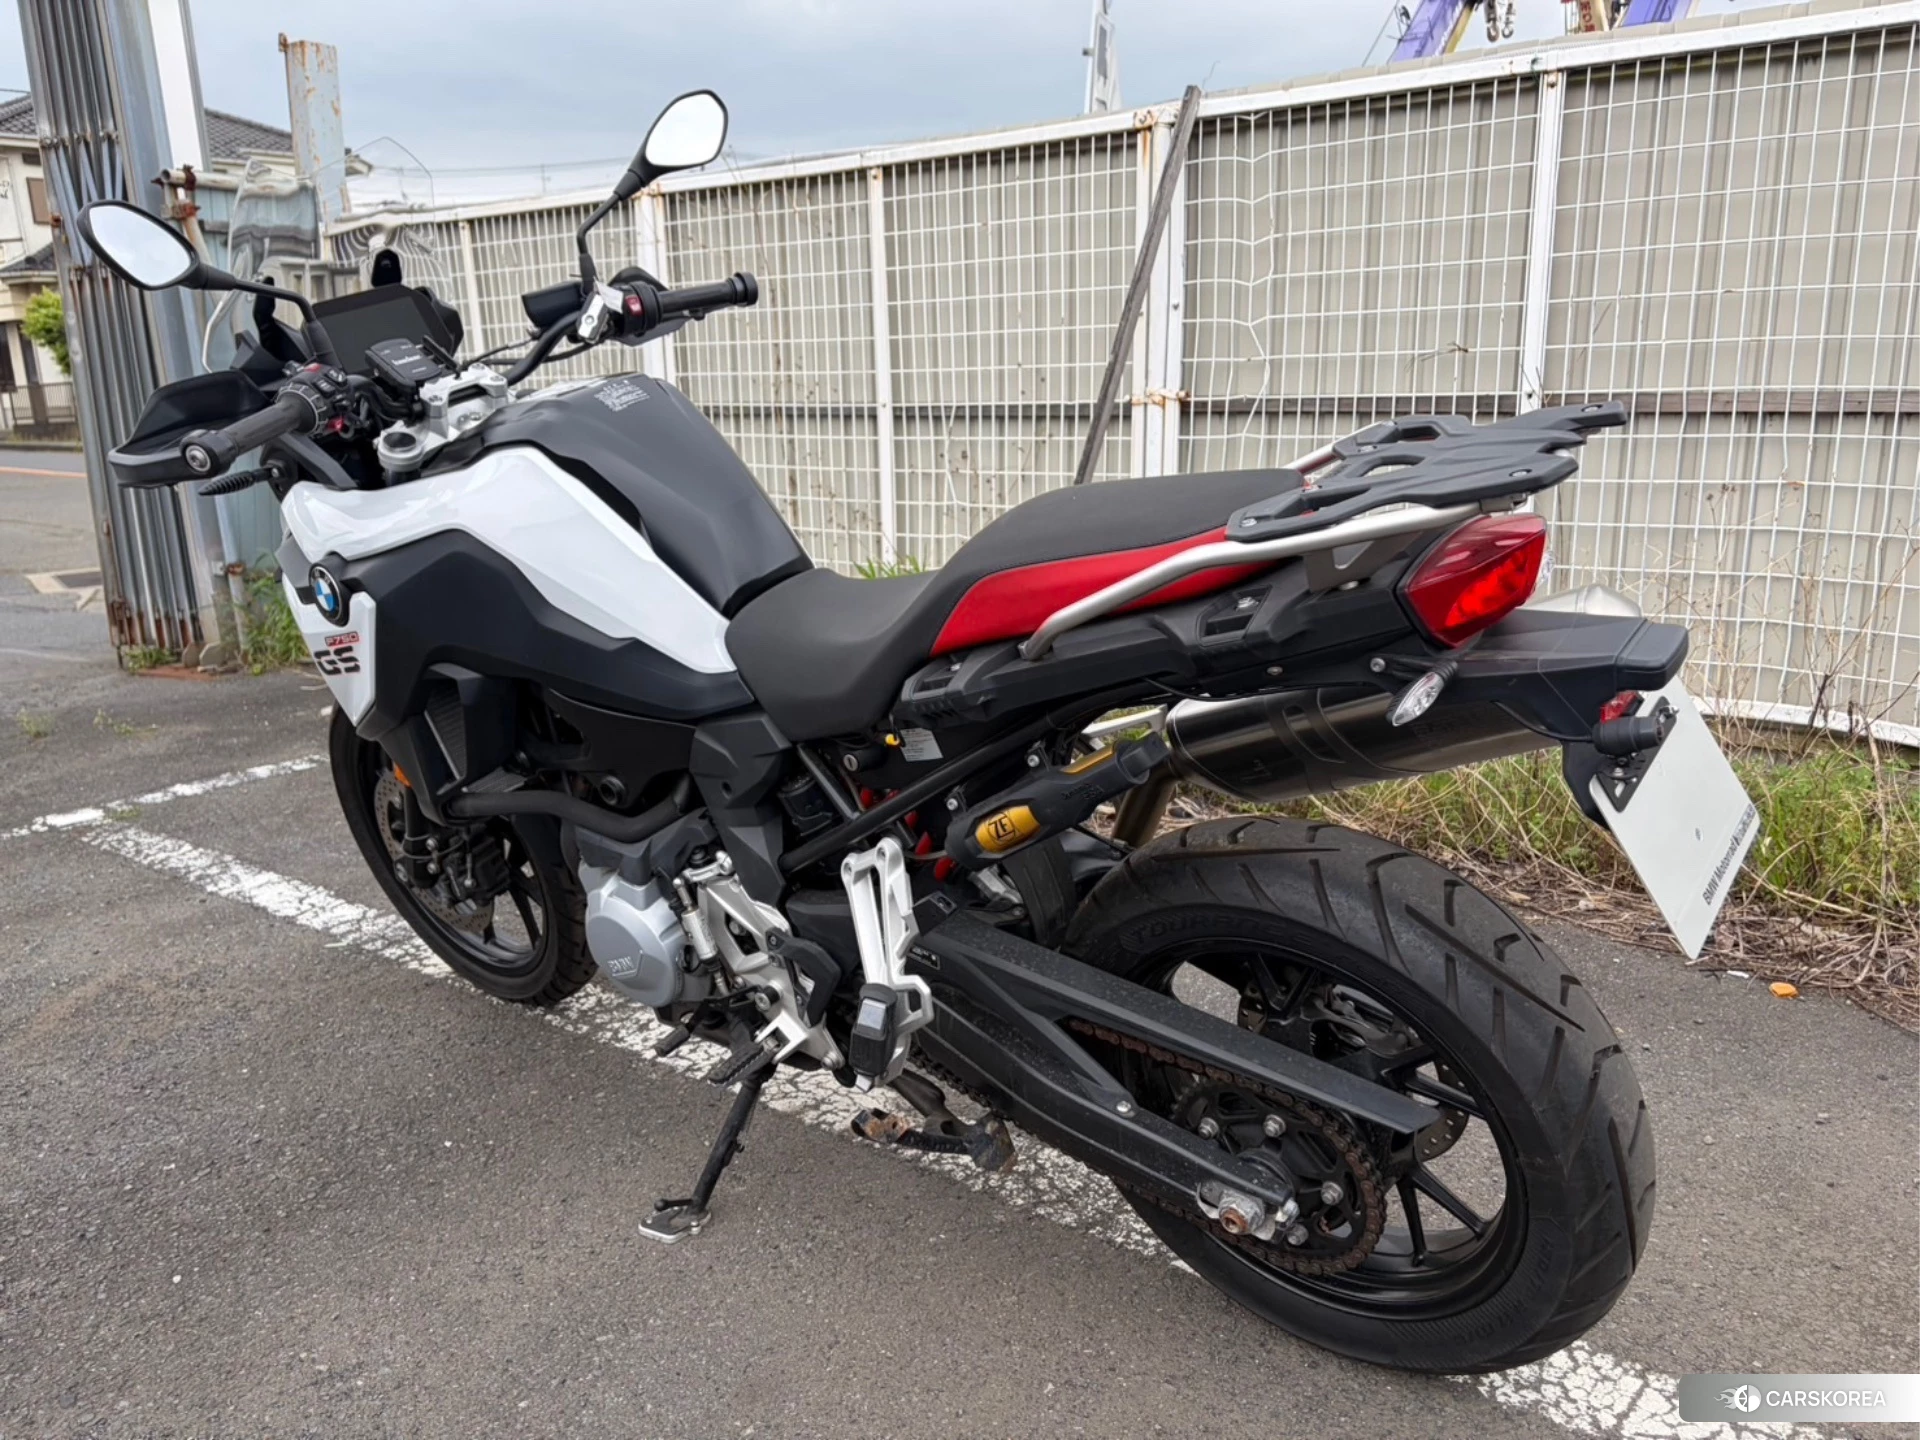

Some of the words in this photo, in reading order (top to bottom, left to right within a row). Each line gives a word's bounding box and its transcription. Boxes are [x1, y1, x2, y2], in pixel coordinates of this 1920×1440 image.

[326, 633, 359, 646] F750
[315, 646, 360, 675] GS
[988, 818, 1009, 840] ZF
[1702, 875, 1719, 906] BMW
